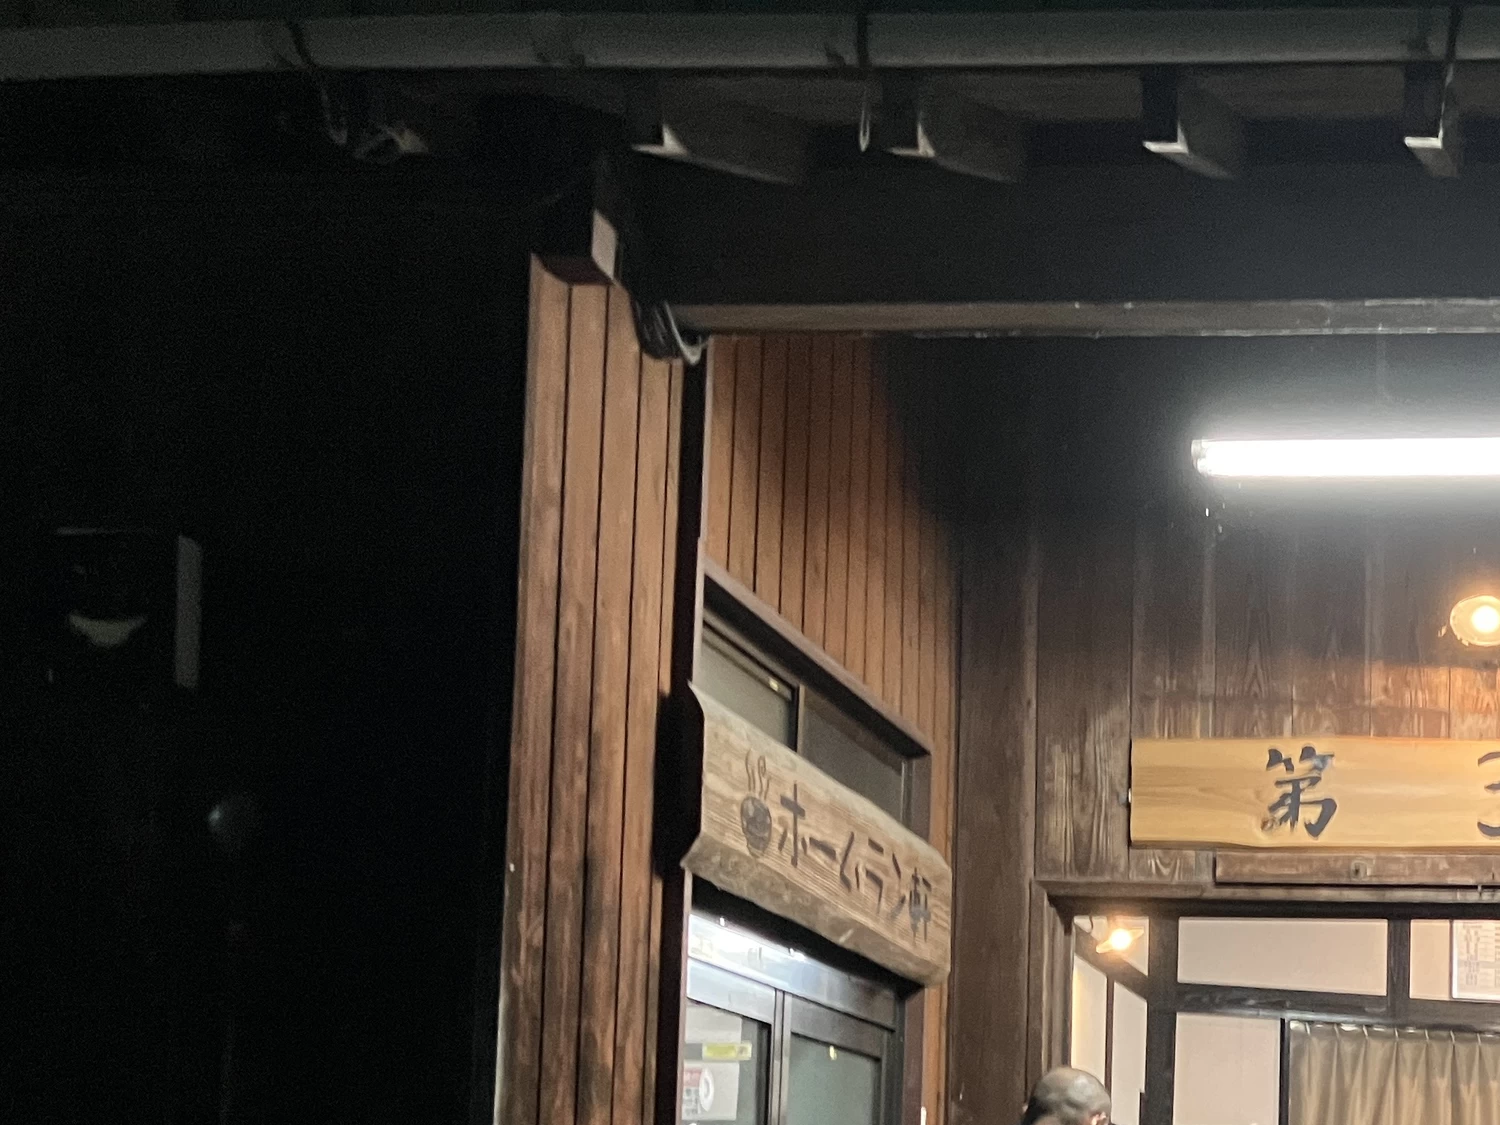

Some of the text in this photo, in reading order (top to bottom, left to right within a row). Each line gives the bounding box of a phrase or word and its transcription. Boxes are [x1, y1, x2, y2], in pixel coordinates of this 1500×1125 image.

[778, 783, 932, 946] ホームラン軒
